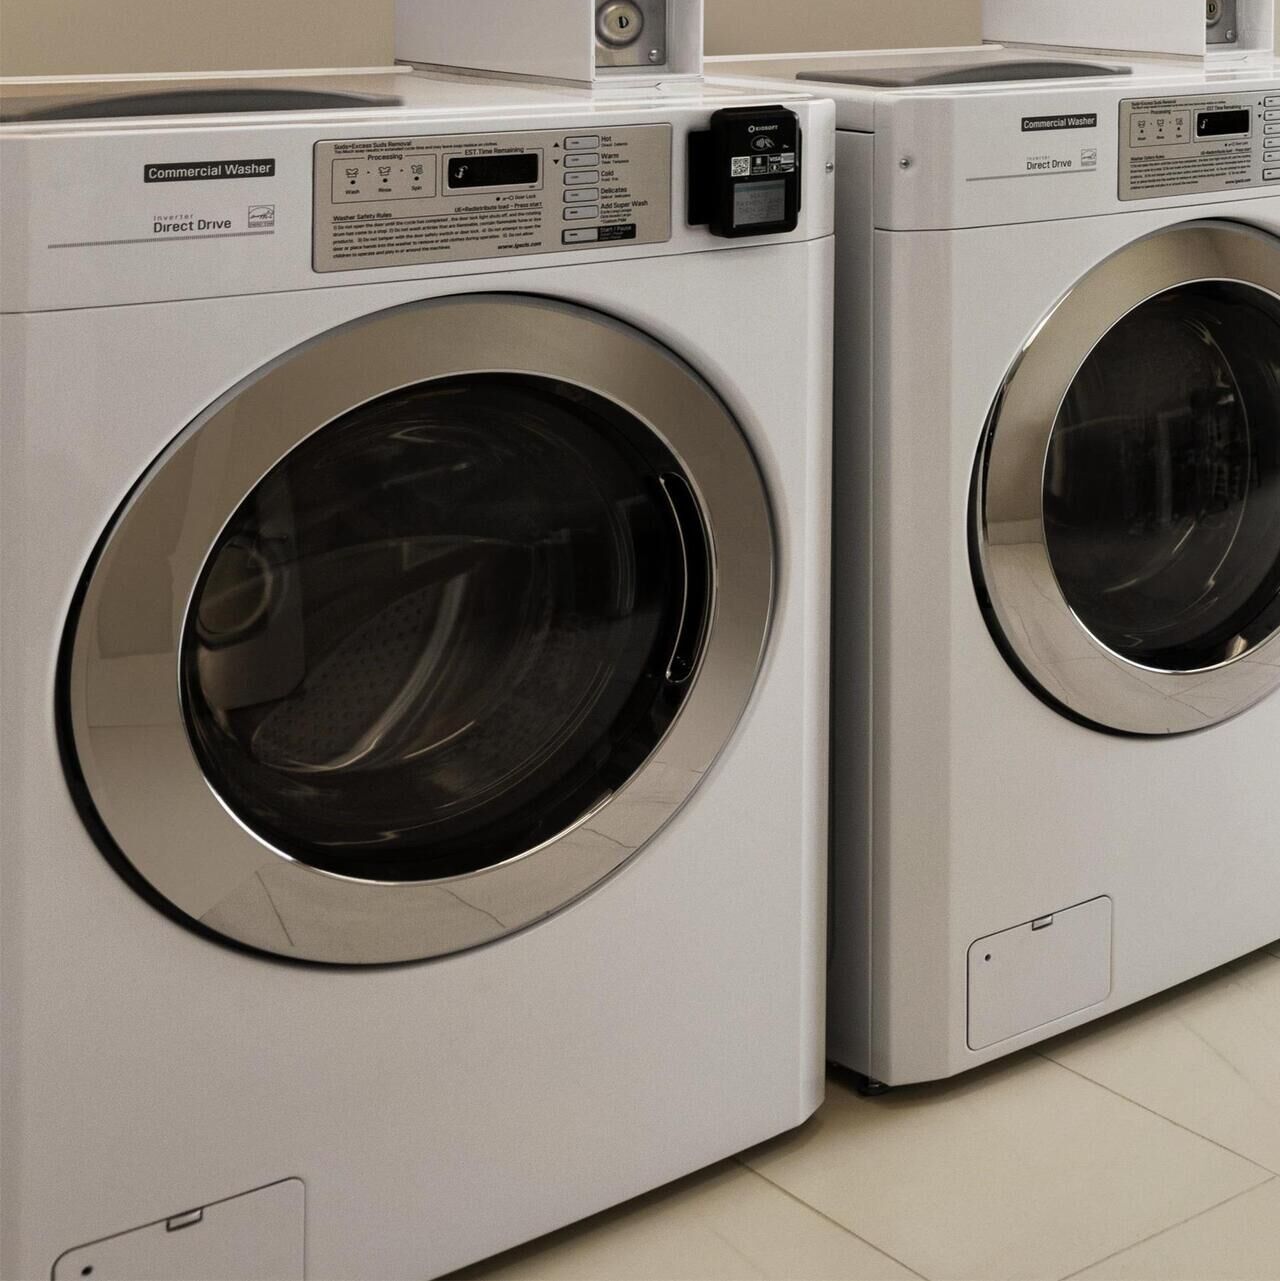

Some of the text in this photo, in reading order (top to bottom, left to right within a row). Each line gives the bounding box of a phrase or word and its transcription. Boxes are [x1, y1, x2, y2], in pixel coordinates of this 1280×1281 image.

[1024, 116, 1095, 129] Commercial Washer
[494, 146, 525, 154] Remaining
[367, 153, 403, 161] Processing
[601, 152, 620, 160] Warm
[1026, 160, 1050, 170] Direct
[1052, 159, 1072, 169] Drive
[149, 164, 271, 179] Commercial Washer
[600, 169, 615, 177] Cold
[600, 186, 628, 194] Delicates
[631, 199, 649, 207] Wash
[153, 219, 232, 233] Direct Drive
